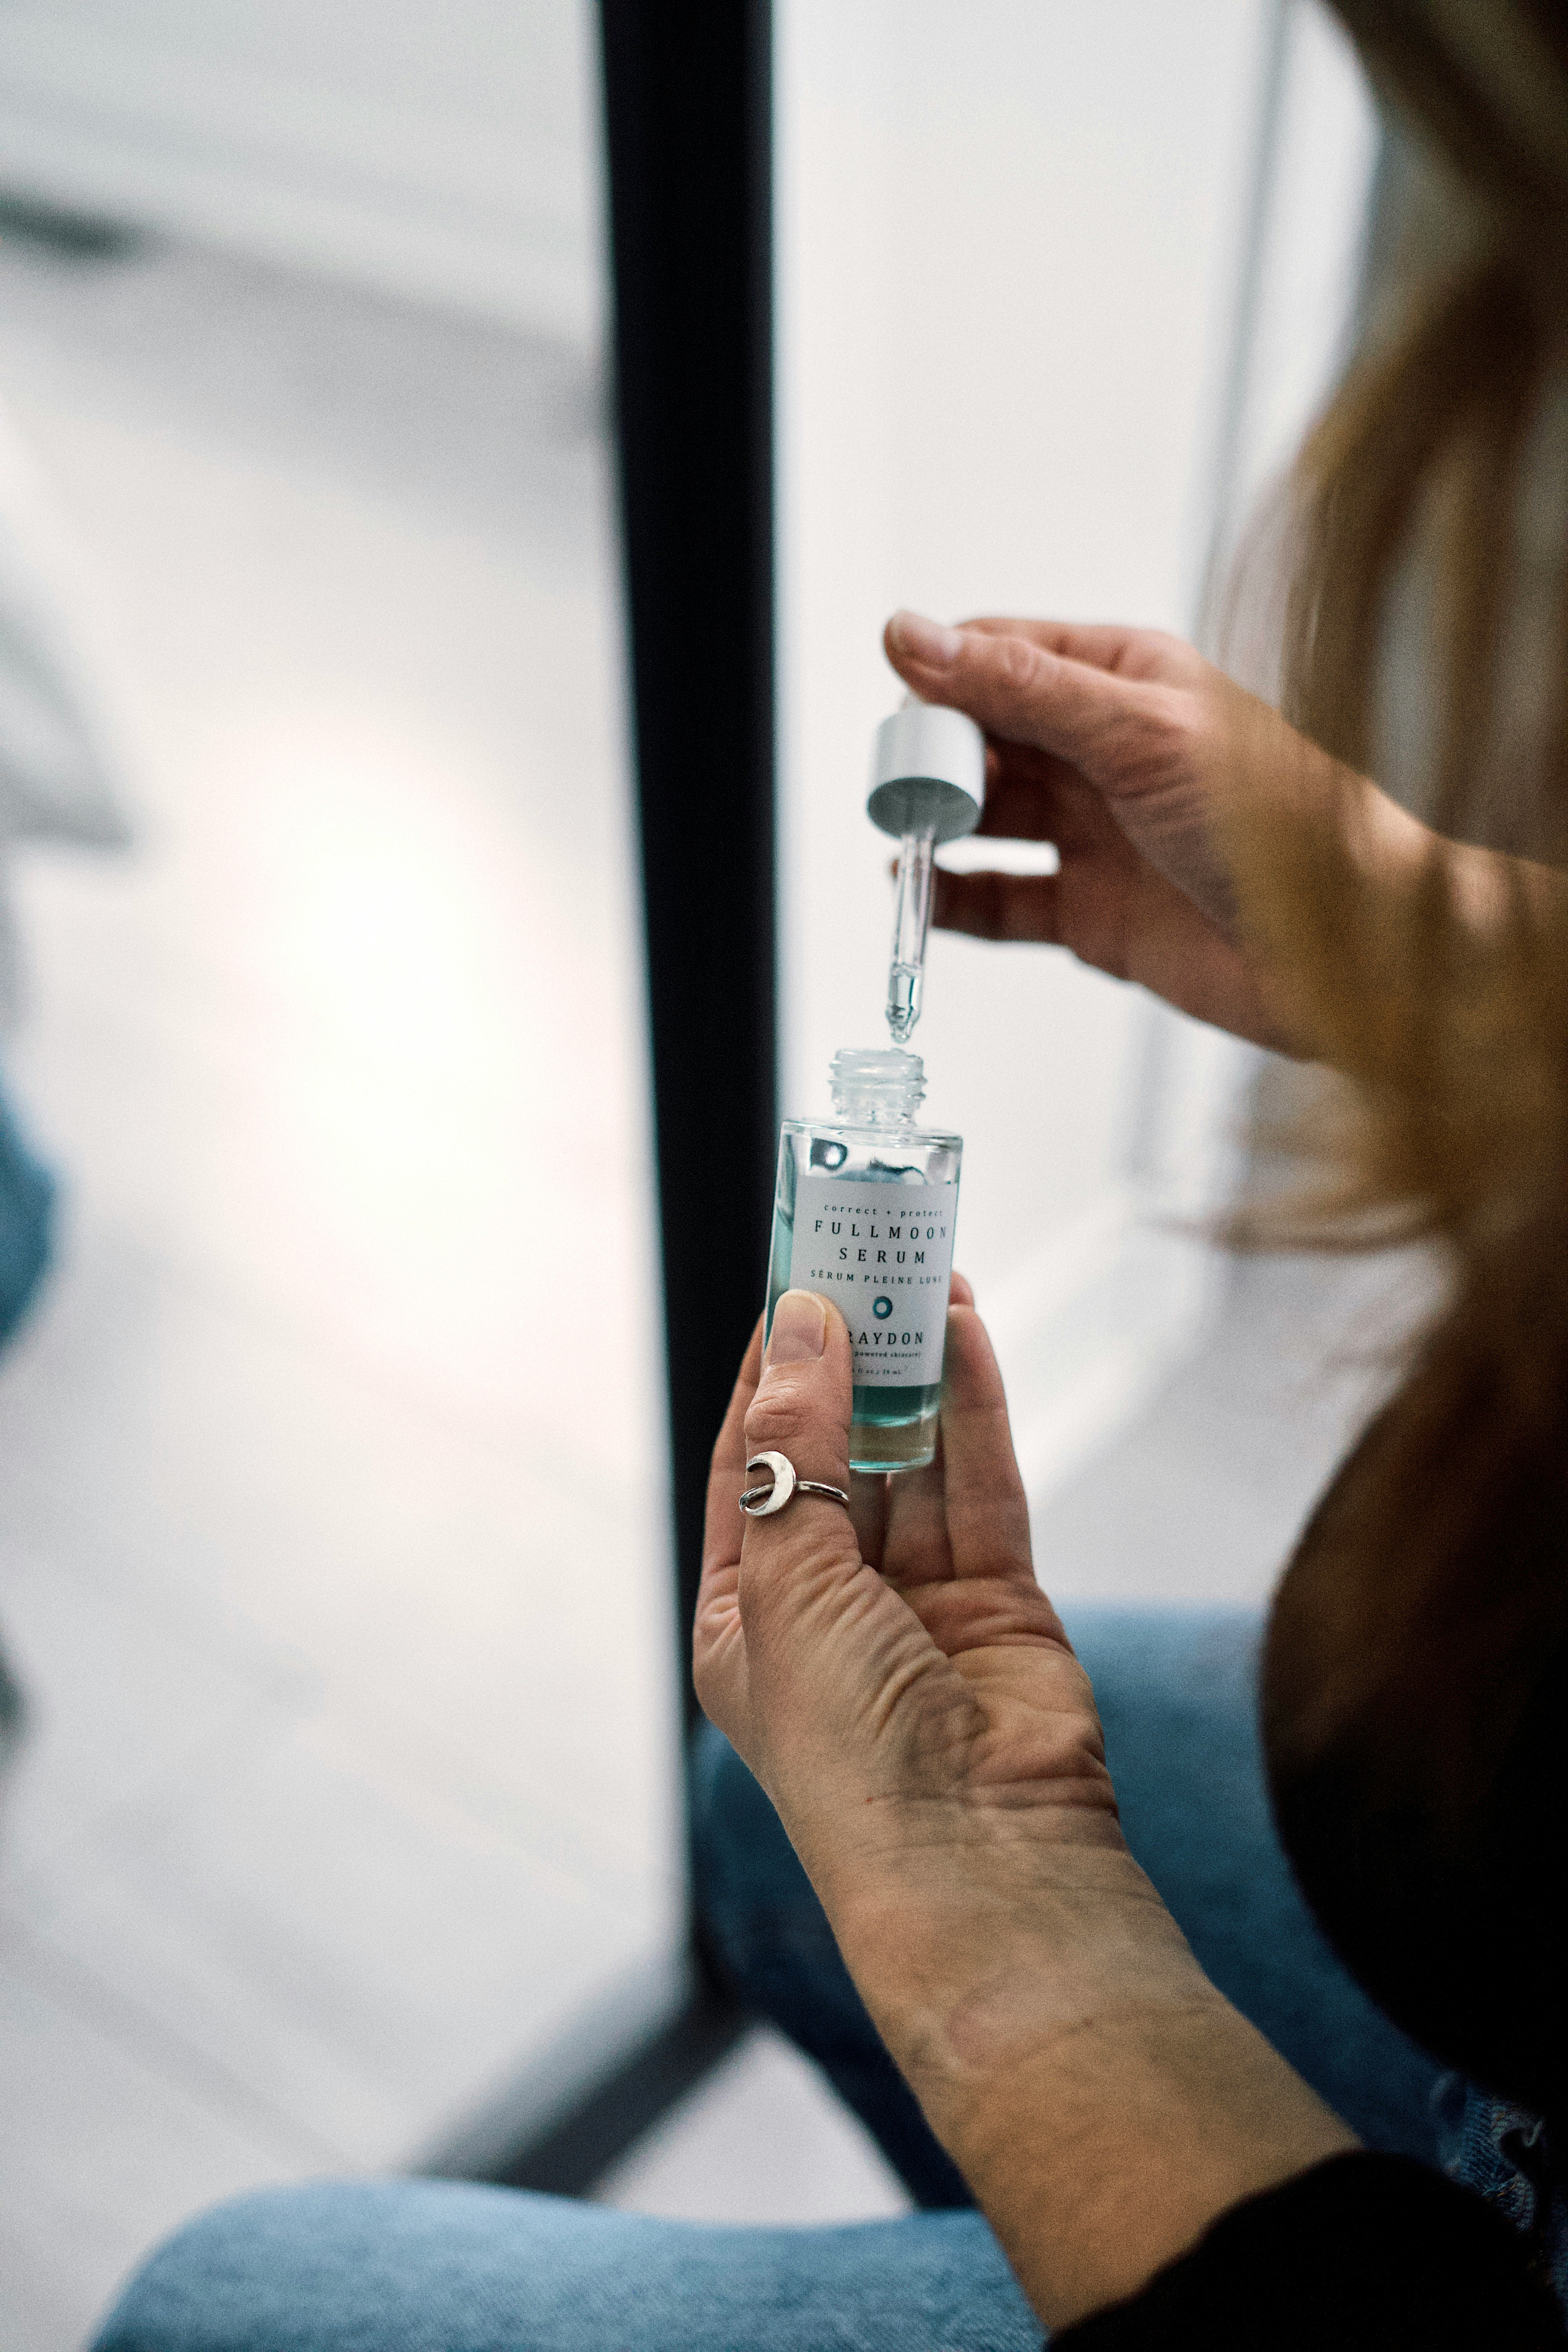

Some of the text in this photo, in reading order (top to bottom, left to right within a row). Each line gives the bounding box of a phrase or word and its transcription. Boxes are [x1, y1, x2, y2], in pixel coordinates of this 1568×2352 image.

[824, 1204, 877, 1215] correct
[815, 1220, 947, 1240] FULLMOON
[839, 1247, 925, 1264] SERUM
[811, 1269, 854, 1281] SÉRUM
[864, 1275, 912, 1284] PLEINE
[848, 1331, 923, 1345] RAYDON
